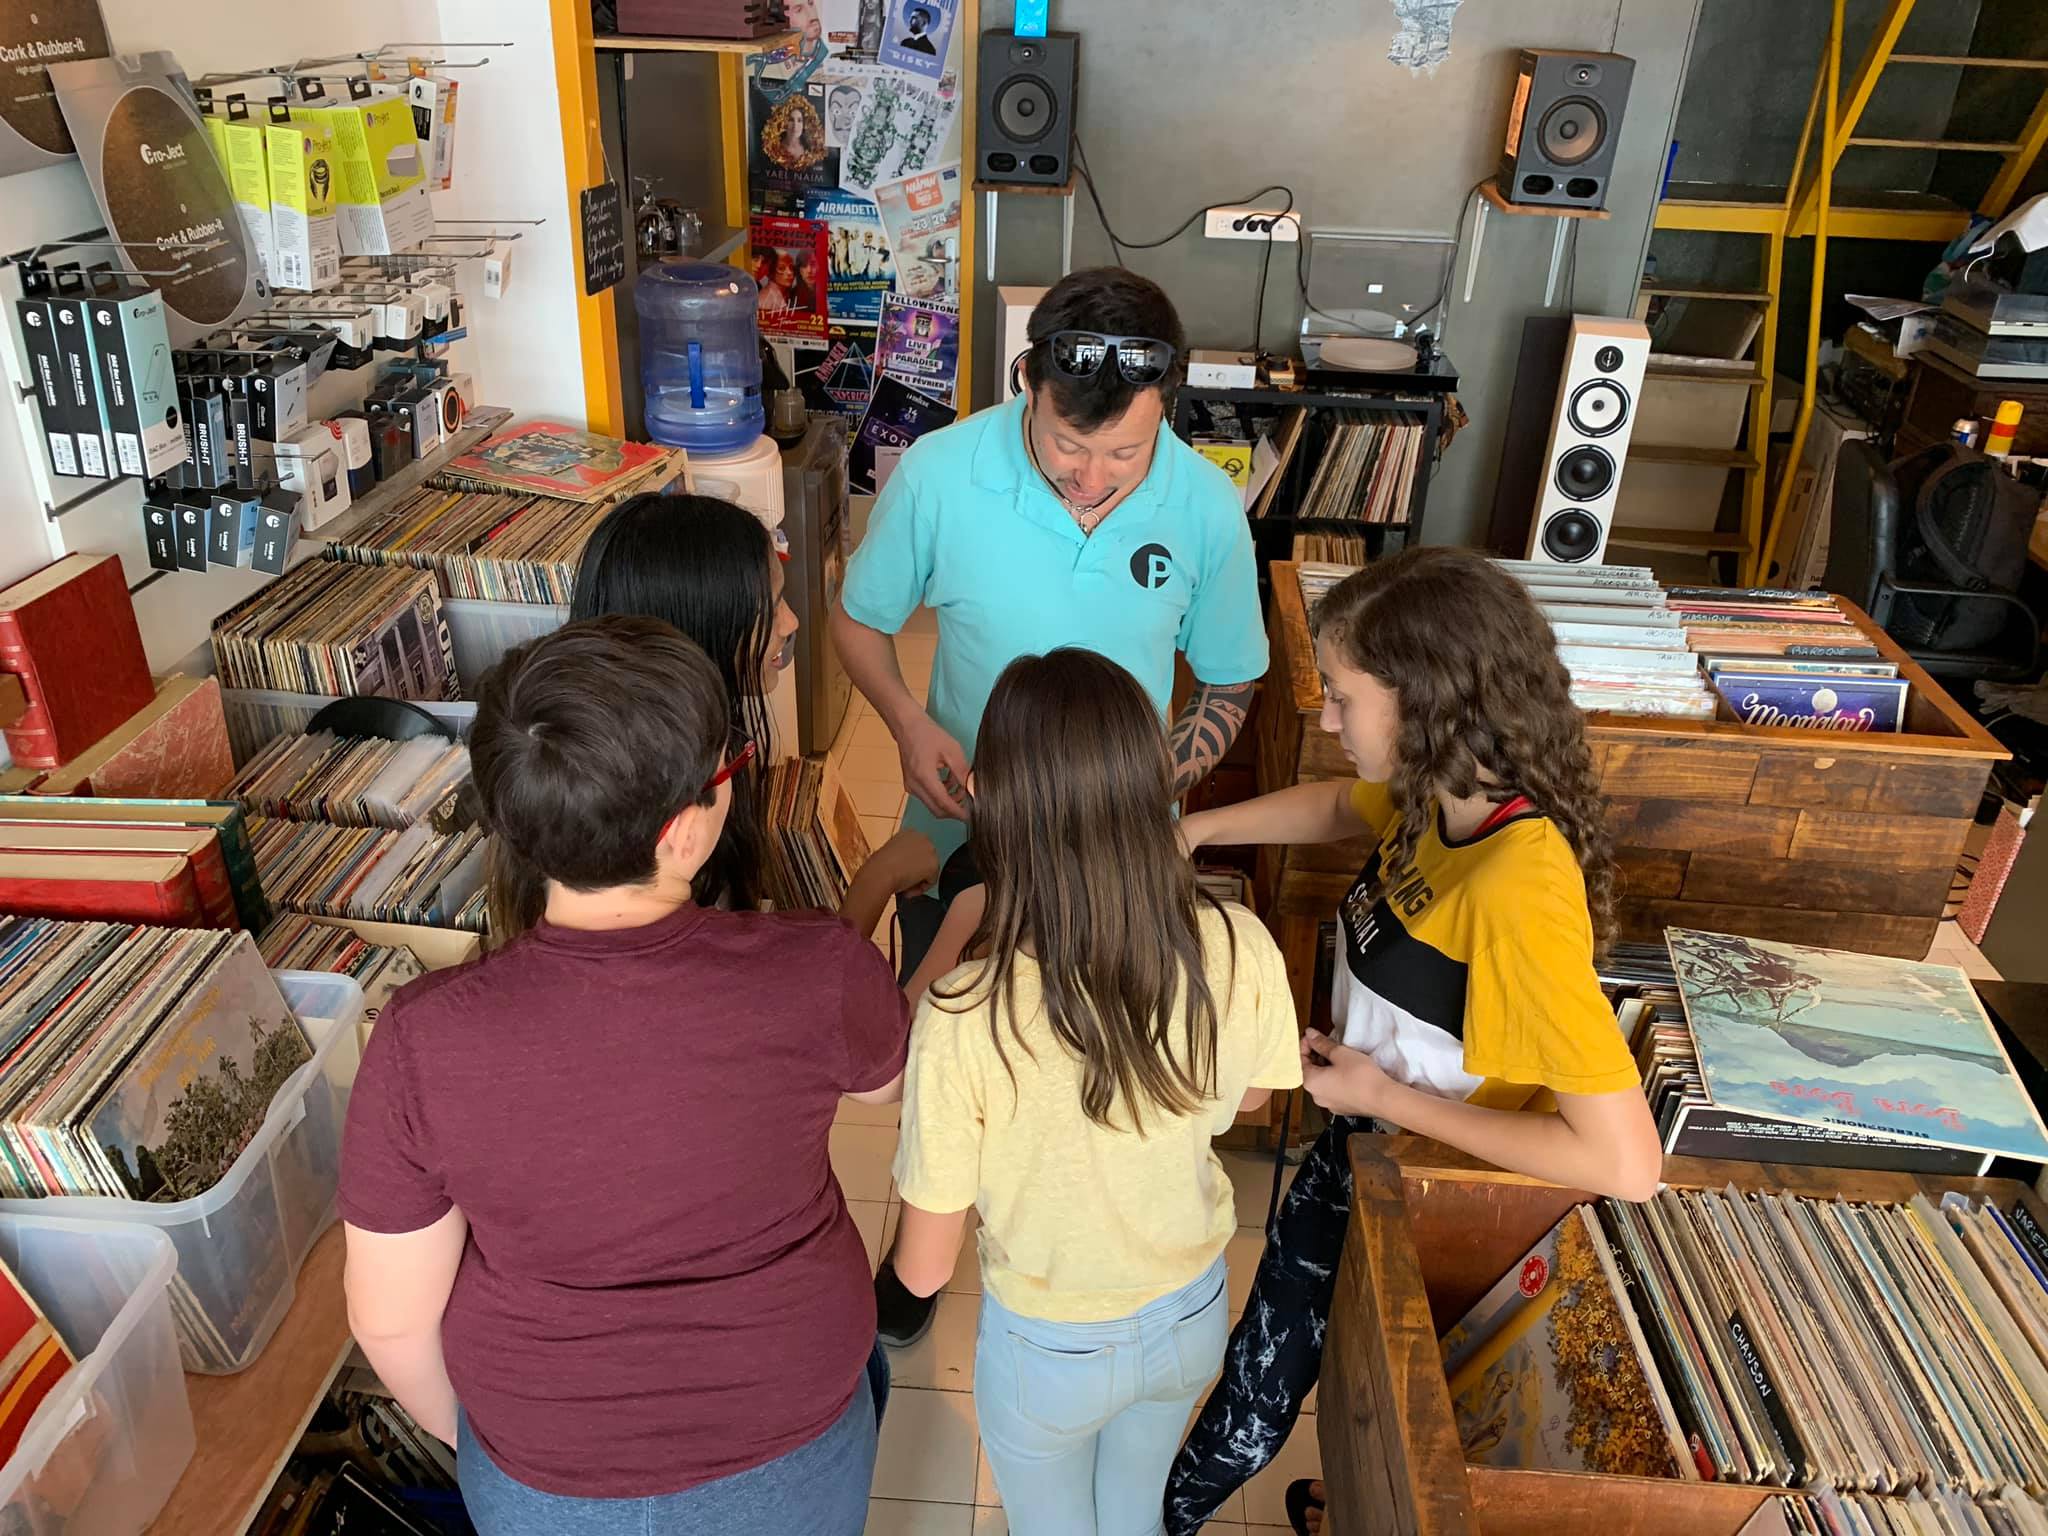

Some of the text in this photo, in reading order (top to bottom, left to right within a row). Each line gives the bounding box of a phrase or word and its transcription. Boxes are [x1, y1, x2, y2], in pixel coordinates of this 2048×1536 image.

[0, 37, 86, 62] Cork & Rubber-it
[888, 48, 941, 69] RISKY
[793, 172, 824, 183] NAIM
[816, 201, 877, 215] AIRNADETT
[156, 218, 225, 251] Cork & Rubber-it
[810, 314, 824, 326] 22
[908, 340, 927, 350] LIVE
[895, 354, 939, 368] PARADISE
[199, 423, 210, 466] BRUSH-IT
[237, 423, 248, 466] BRUSH-IT
[871, 424, 908, 448] EXOD
[1648, 611, 1672, 619] ASIE
[1656, 653, 1688, 661] TAHITI
[1791, 646, 1849, 656] BAROQUE
[1823, 1117, 1930, 1139] STEREOPHONIC
[1732, 1322, 1772, 1398] CHANSON
